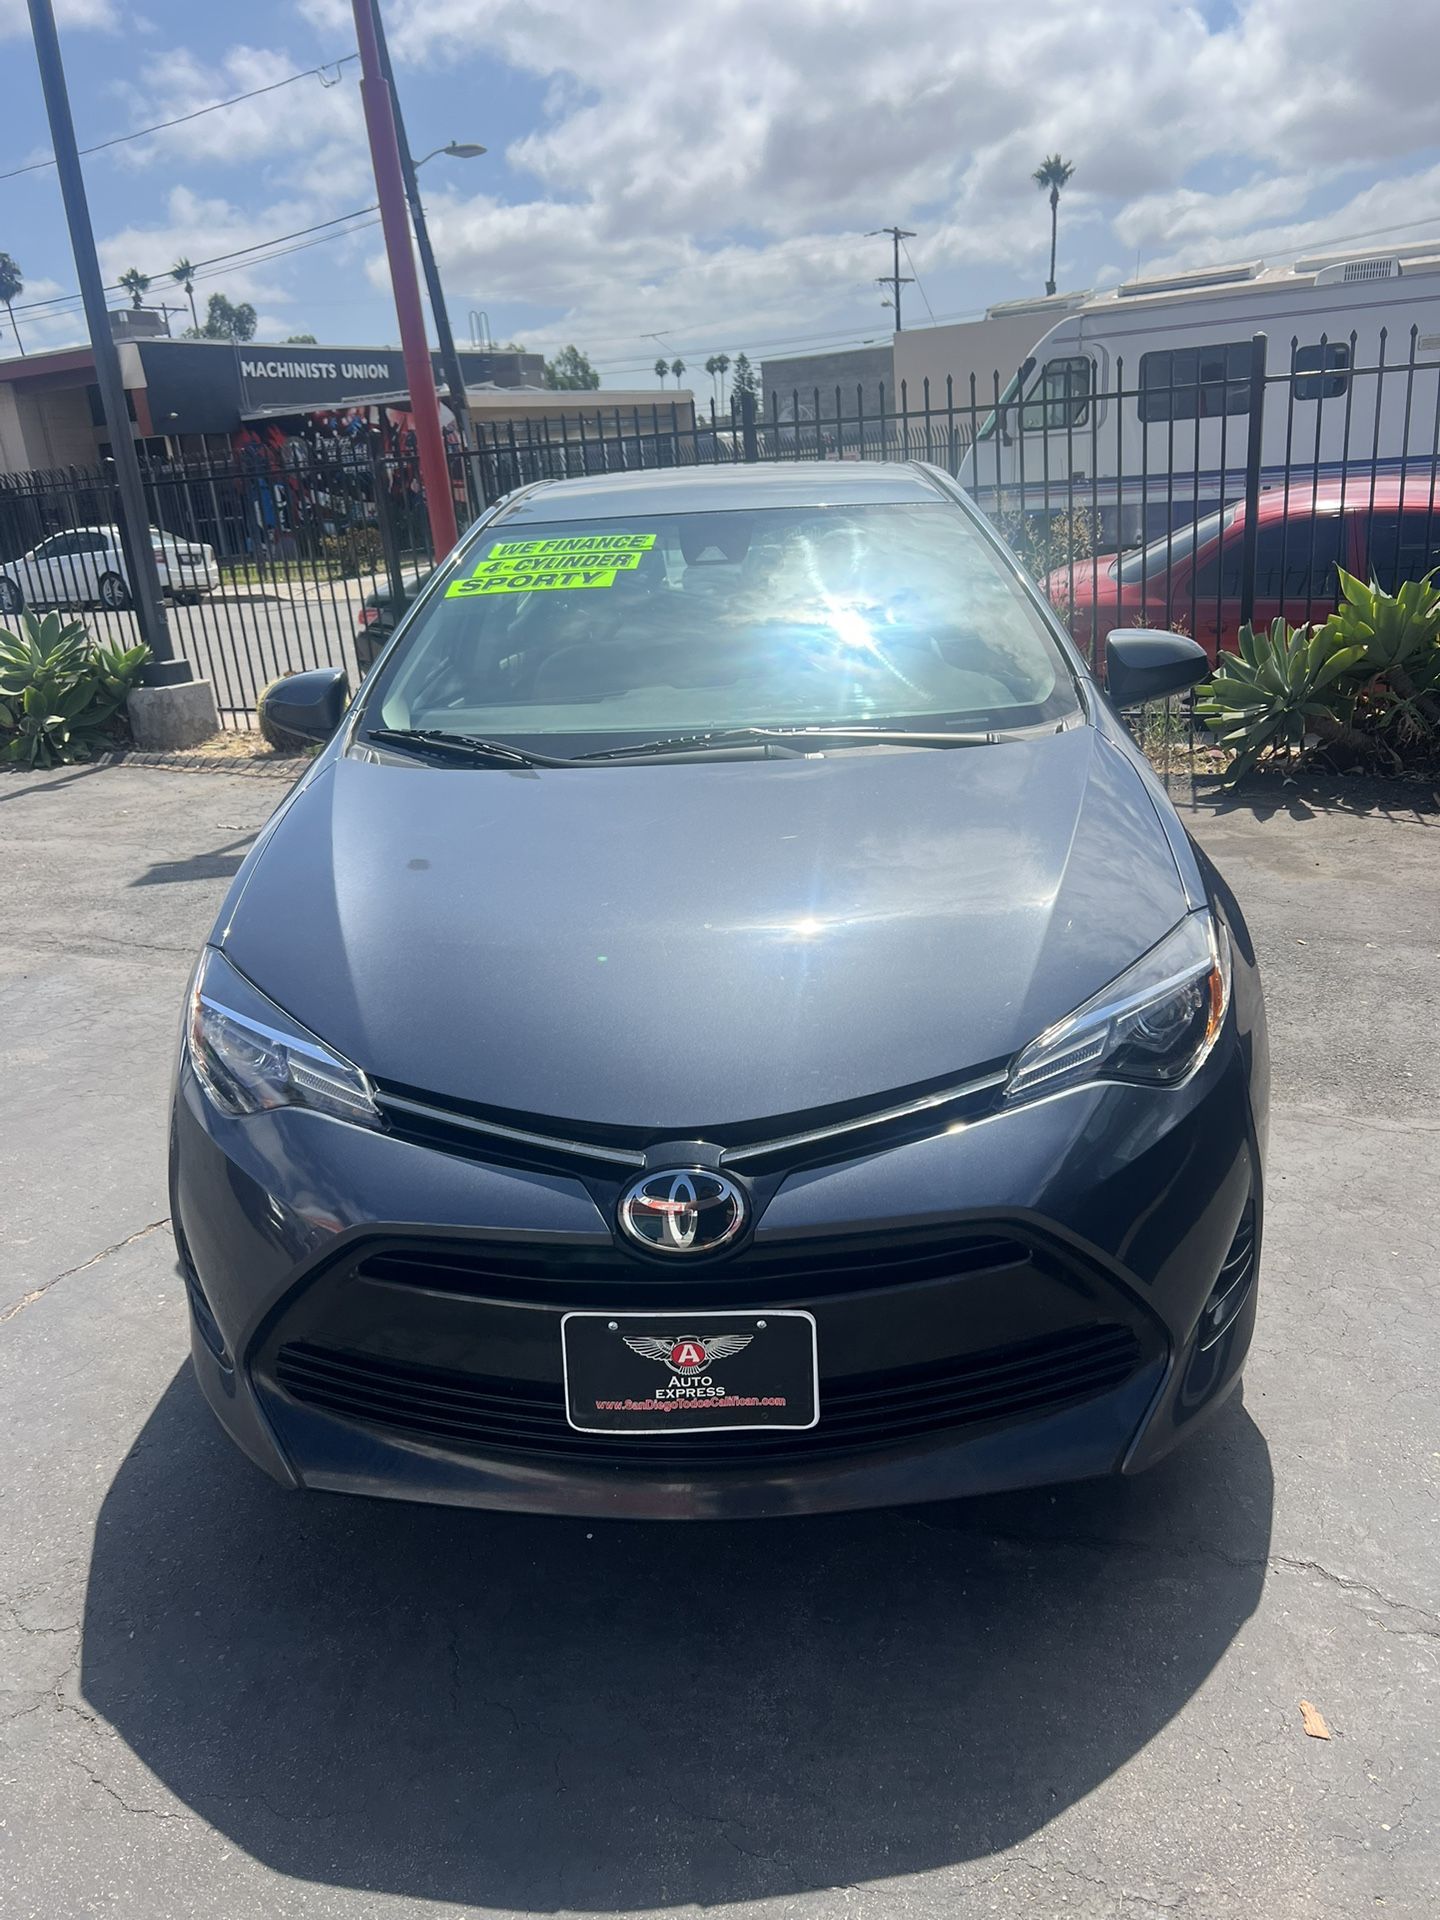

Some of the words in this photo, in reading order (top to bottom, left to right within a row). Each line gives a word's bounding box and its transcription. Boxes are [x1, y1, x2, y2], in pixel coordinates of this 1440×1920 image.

[240, 361, 337, 378] MACHINISTS
[341, 364, 389, 379] UNION
[500, 542, 539, 556] WE
[542, 535, 648, 554] FINANCE
[483, 552, 635, 574] 4-CYLINDER
[458, 570, 604, 593] SPORTY
[678, 1344, 700, 1363] A
[668, 1376, 713, 1388] AUTO
[655, 1386, 726, 1399] EXPRESS
